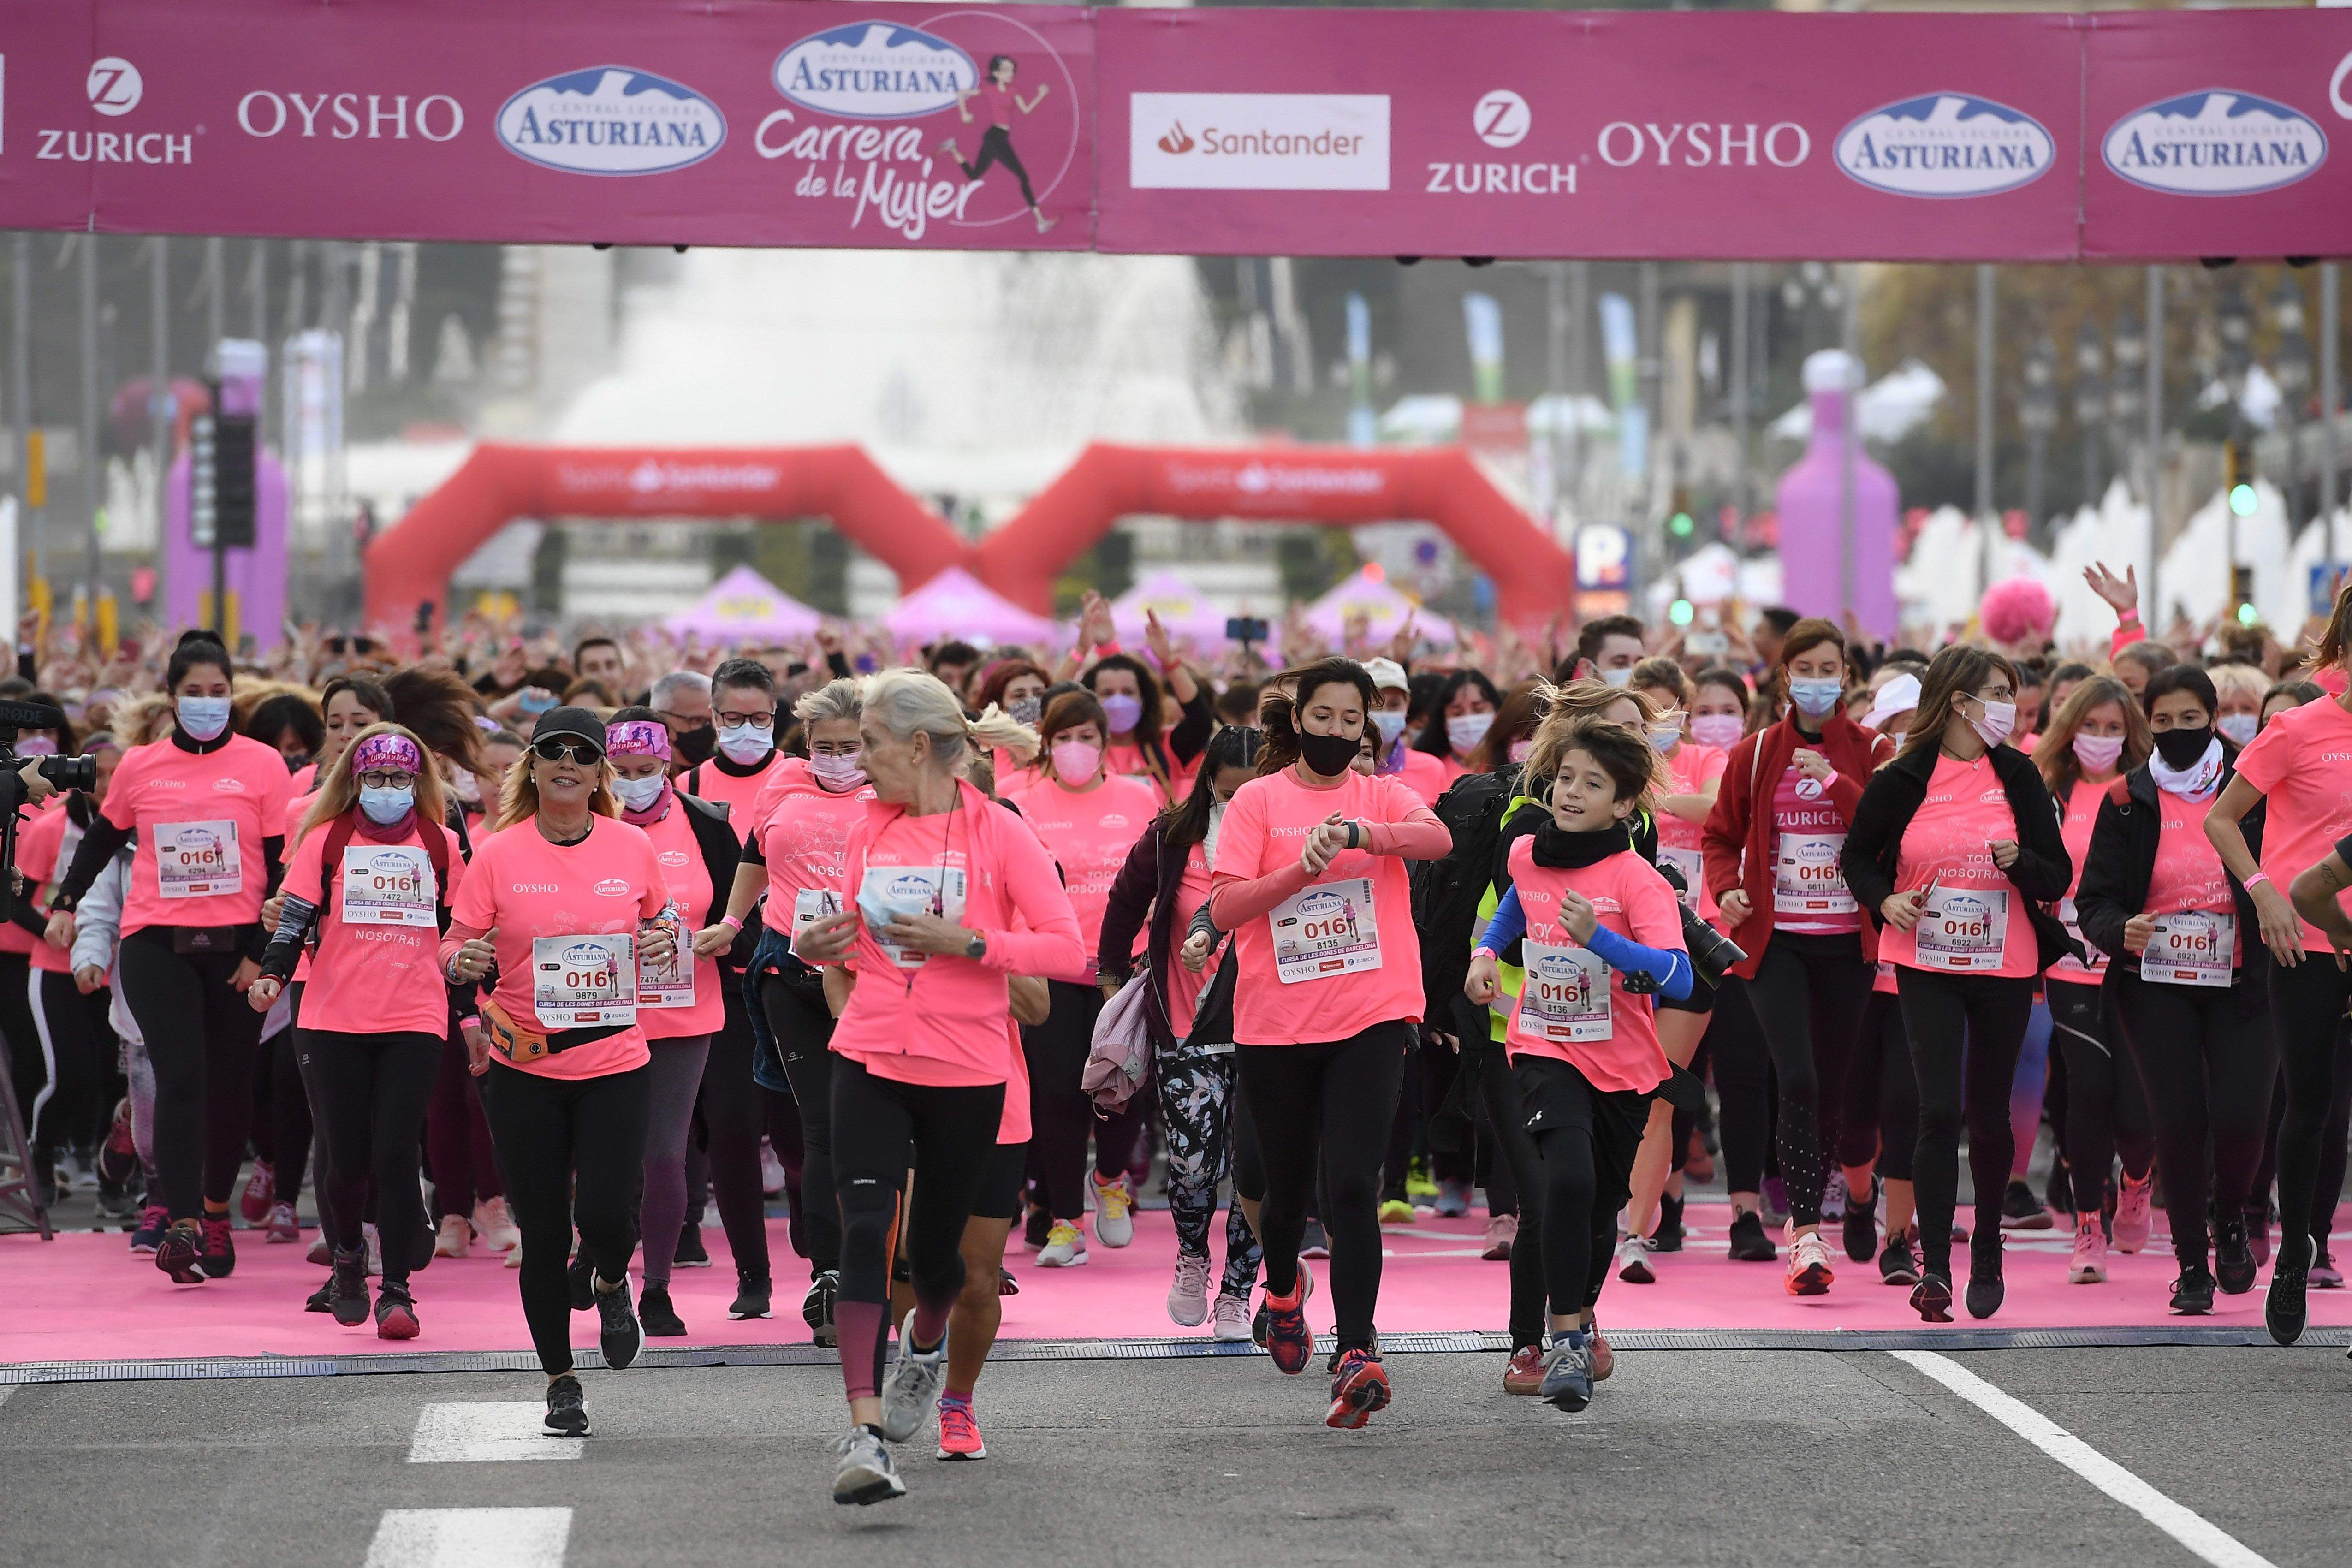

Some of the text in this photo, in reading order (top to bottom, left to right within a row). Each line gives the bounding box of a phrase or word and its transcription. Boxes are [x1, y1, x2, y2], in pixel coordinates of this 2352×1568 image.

[790, 56, 959, 92] ASTURIANA
[237, 90, 464, 142] OYSHO
[515, 105, 707, 147] ASTURIANA
[757, 109, 922, 161] Carrera
[1202, 128, 1362, 155] Santander
[36, 130, 193, 164] ZURICH
[1598, 121, 1810, 169] OYSHO
[1853, 131, 2035, 169] ASTURIANA
[2122, 130, 2307, 166] ASTURIANA
[1427, 164, 1576, 193] ZURICH
[795, 158, 984, 240] de la Mujer
[1776, 811, 1843, 826] ZURICH
[180, 851, 214, 865] 016
[374, 860, 410, 868] ASTURIANA
[1800, 866, 1834, 879] 016
[373, 876, 411, 891] 016
[513, 884, 558, 893] OYSHO
[892, 885, 932, 895] ASTURIANA
[1301, 900, 1342, 912] ASTURIANA
[1947, 903, 1982, 912] ASTURIANA
[1305, 918, 1346, 938] 016
[1944, 921, 1981, 936] 016
[2173, 917, 2207, 927] ASTURIANA
[356, 930, 421, 947] NOSOTRAS
[1317, 939, 1338, 950] 8135
[2170, 934, 2207, 950] 016
[1346, 943, 1376, 953] BARCELONA
[566, 952, 606, 960] ASTURIANA
[1919, 953, 1945, 962] OYSHO
[1283, 966, 1315, 977] OYSHO
[1541, 963, 1577, 974] ASTURIANA
[566, 971, 607, 987] 016
[1541, 983, 1578, 1002] 016
[1548, 1004, 1568, 1014] 8136
